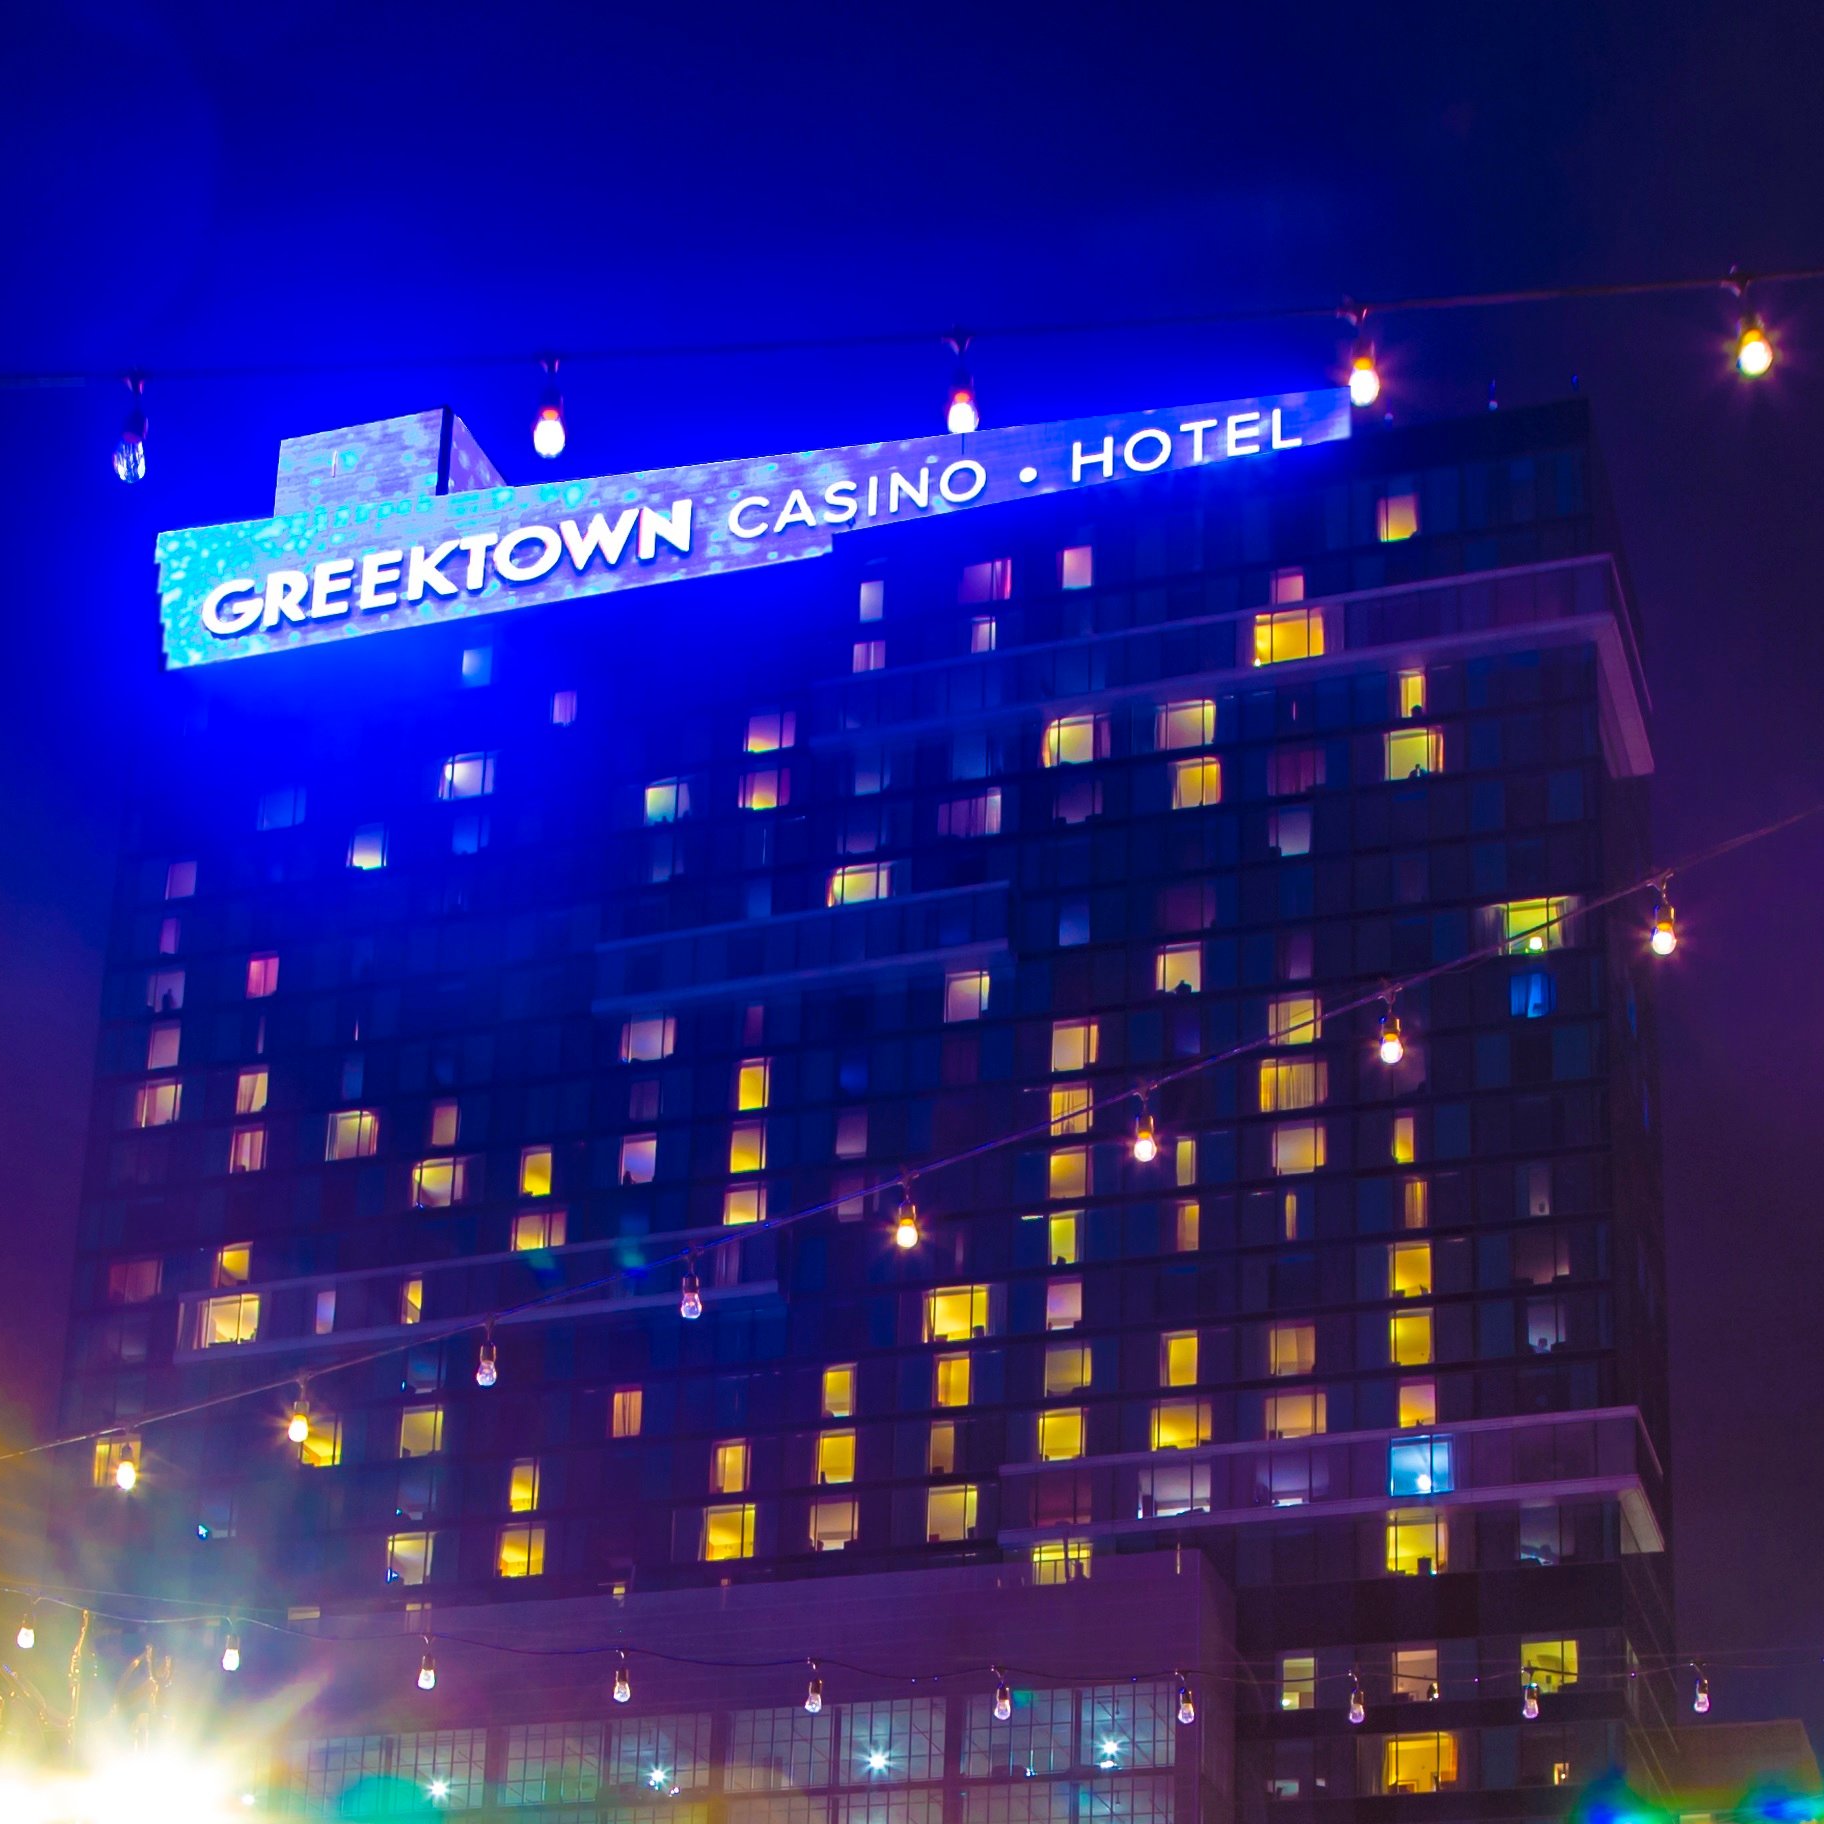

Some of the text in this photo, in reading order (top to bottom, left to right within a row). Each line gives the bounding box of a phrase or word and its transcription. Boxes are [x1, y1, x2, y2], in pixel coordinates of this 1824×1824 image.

[200, 406, 1304, 640] GREEKTOWN CASINO HOTEL
